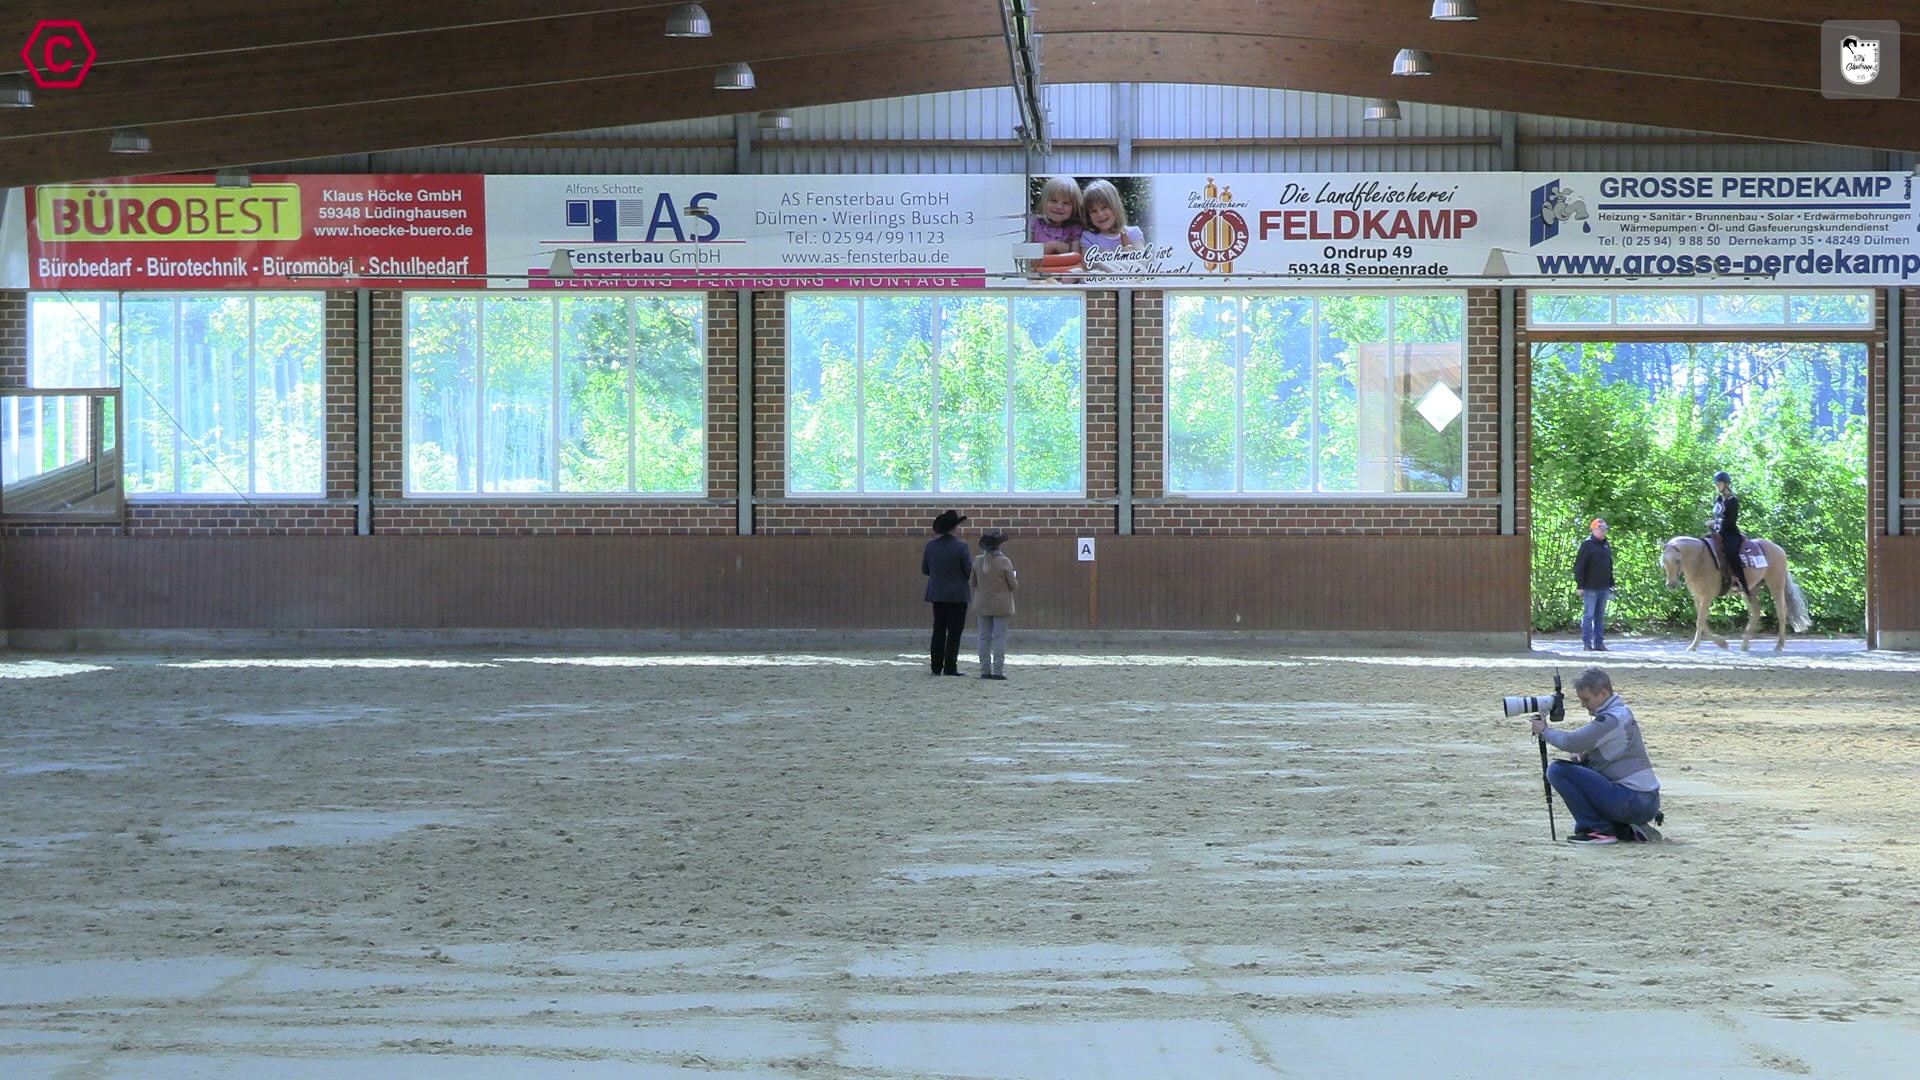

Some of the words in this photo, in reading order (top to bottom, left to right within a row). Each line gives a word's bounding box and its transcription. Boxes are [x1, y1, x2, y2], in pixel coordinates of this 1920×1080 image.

[566, 184, 600, 194] Alfons
[602, 184, 644, 194] Schotte
[1600, 176, 1713, 198] GROSSE
[1722, 176, 1892, 198] PERDEKAMP
[323, 190, 363, 202] Klaus
[368, 190, 413, 202] Höcke
[417, 190, 462, 202] GmbH
[781, 192, 800, 206] AS
[807, 192, 894, 206] Fensterbau
[900, 192, 949, 206] GmbH
[1279, 183, 1311, 205] Die
[1315, 181, 1459, 211] Landfleischerei
[52, 190, 288, 235] BÜROBEST
[319, 207, 361, 219] 59348
[365, 207, 467, 221] Lüdinghausen
[645, 192, 721, 242] AS
[756, 211, 818, 225] Dülmen
[832, 211, 906, 228] Wierlings
[912, 211, 959, 225] Busch
[965, 212, 974, 225] 3
[1598, 213, 1640, 223] Heizung
[1649, 212, 1686, 221] Sanitär
[1695, 212, 1758, 221] Brunnenbau
[1767, 212, 1794, 221] Solar
[1803, 212, 1911, 222] Erdwärmebohrungen
[314, 224, 473, 236] www.hoecke-buero.de
[1259, 209, 1478, 240] FELDKAMP
[1620, 223, 1697, 233] Wärmepumpen
[1725, 223, 1745, 232] und
[1747, 223, 1889, 233] Gasfeuerungskundendienst
[786, 231, 817, 244] Tel.:
[1598, 236, 1618, 246] Tel.
[1728, 236, 1797, 248] Dernekamp
[1801, 236, 1814, 246] 35
[1825, 236, 1860, 246] 48249
[1864, 235, 1910, 246] Dülmen
[1190, 231, 1247, 262] FELDKAMP
[1323, 246, 1388, 262] Ondrup
[1392, 246, 1413, 259] 49
[568, 249, 664, 264] Fensterbau
[669, 249, 721, 264] GmbH
[782, 249, 949, 264] www.as-fensterbau.de
[1085, 244, 1152, 268] Geschmack
[1156, 246, 1174, 258] ist
[39, 258, 132, 277] Bürobedarf
[147, 257, 248, 277] Bürotechnik
[369, 256, 469, 275] Schulbedarf
[1288, 263, 1340, 275] 59348
[1345, 262, 1449, 276] Seppenrade
[1082, 544, 1091, 555] A
